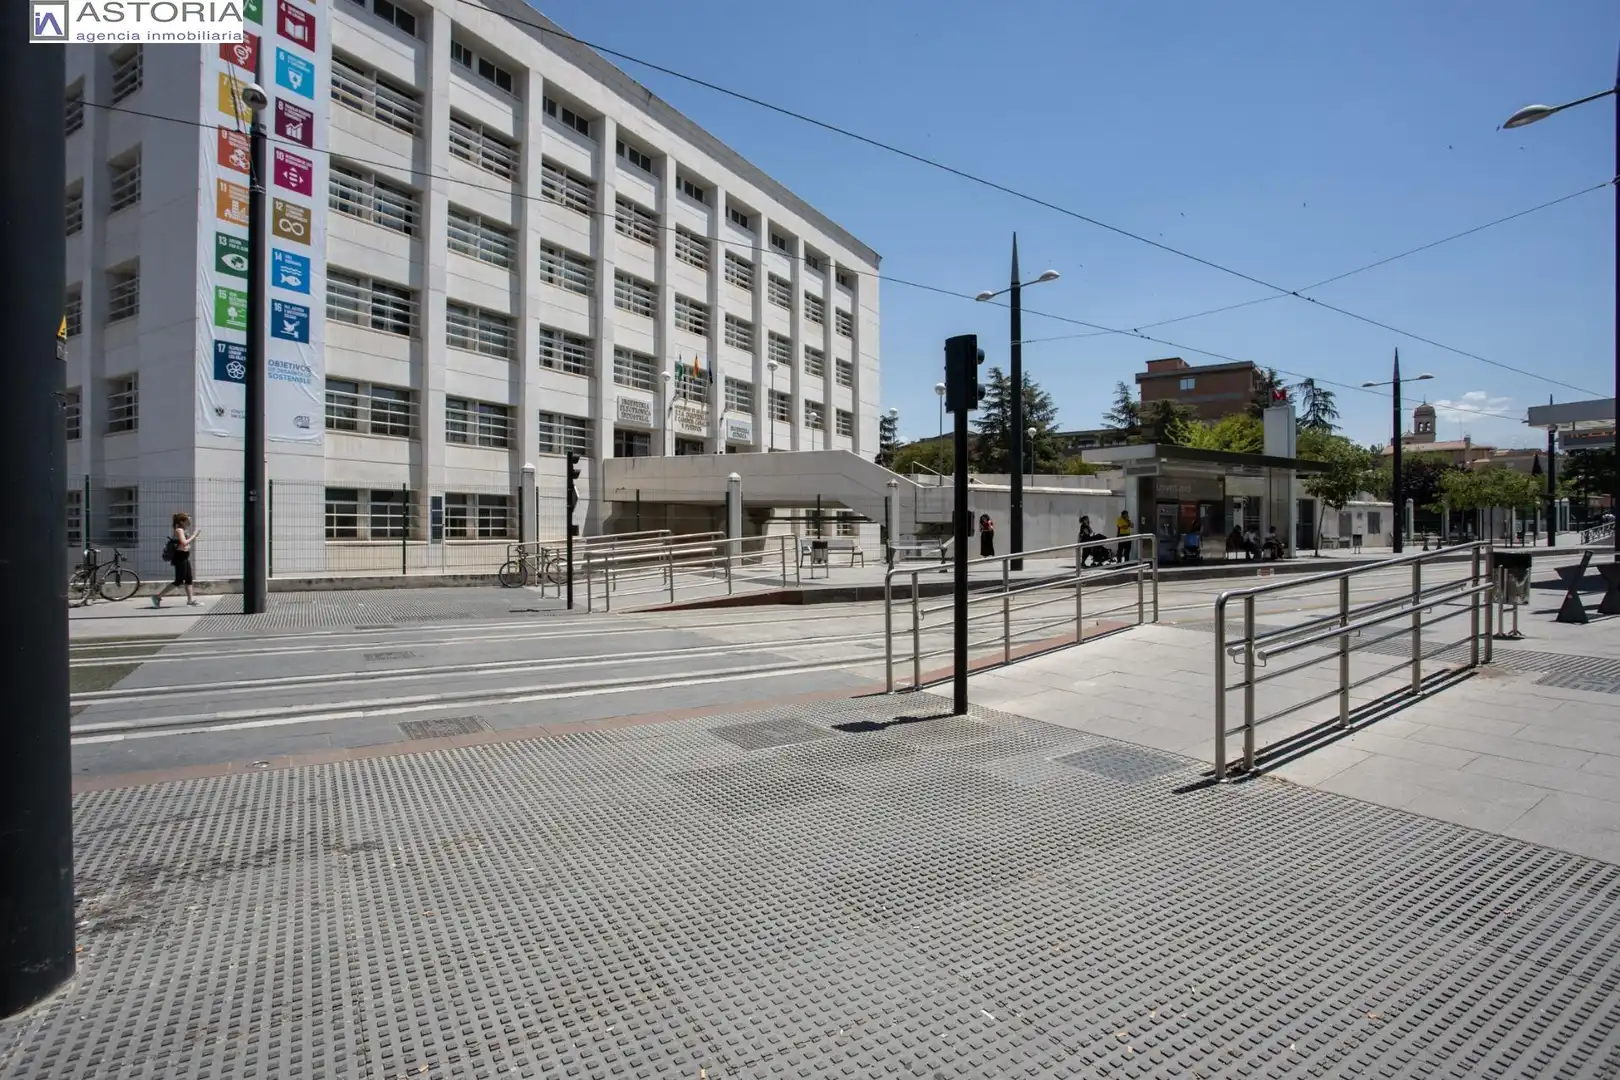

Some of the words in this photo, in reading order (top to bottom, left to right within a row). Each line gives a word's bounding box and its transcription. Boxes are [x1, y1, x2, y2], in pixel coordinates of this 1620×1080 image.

[276, 150, 285, 161] 10
[218, 235, 227, 246] 13
[274, 252, 283, 262] 14
[274, 302, 283, 312] 16
[218, 343, 226, 353] 17
[268, 359, 311, 373] OBJETIVOS
[268, 372, 311, 384] SOSTENIBLE
